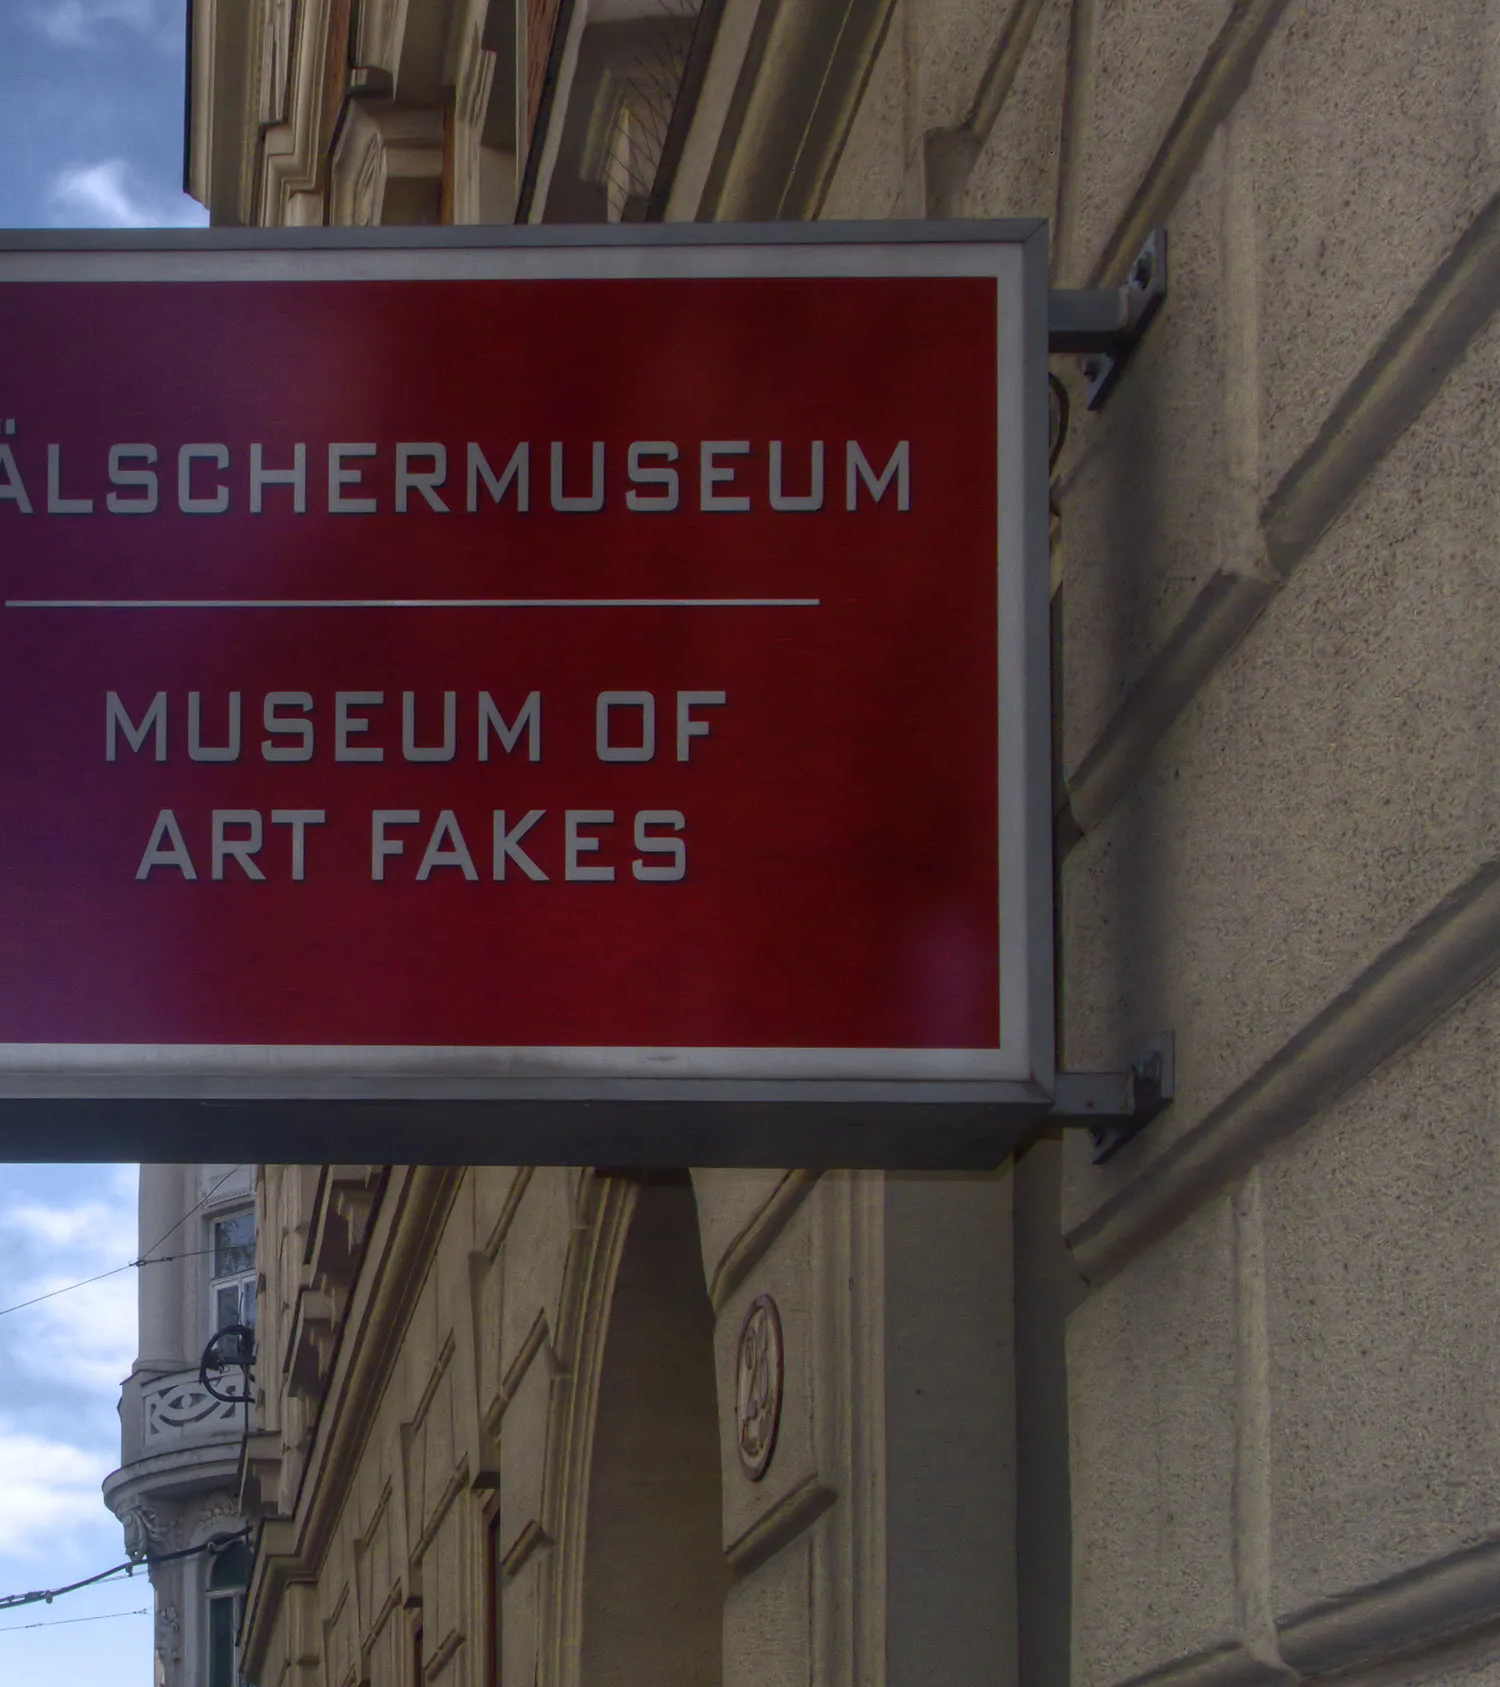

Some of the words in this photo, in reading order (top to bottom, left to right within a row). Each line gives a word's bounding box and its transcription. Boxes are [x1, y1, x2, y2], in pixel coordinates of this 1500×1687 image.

[105, 690, 541, 762] MUSEUM
[596, 690, 727, 762] OF
[135, 809, 327, 880] ART
[371, 809, 687, 881] FAKES
